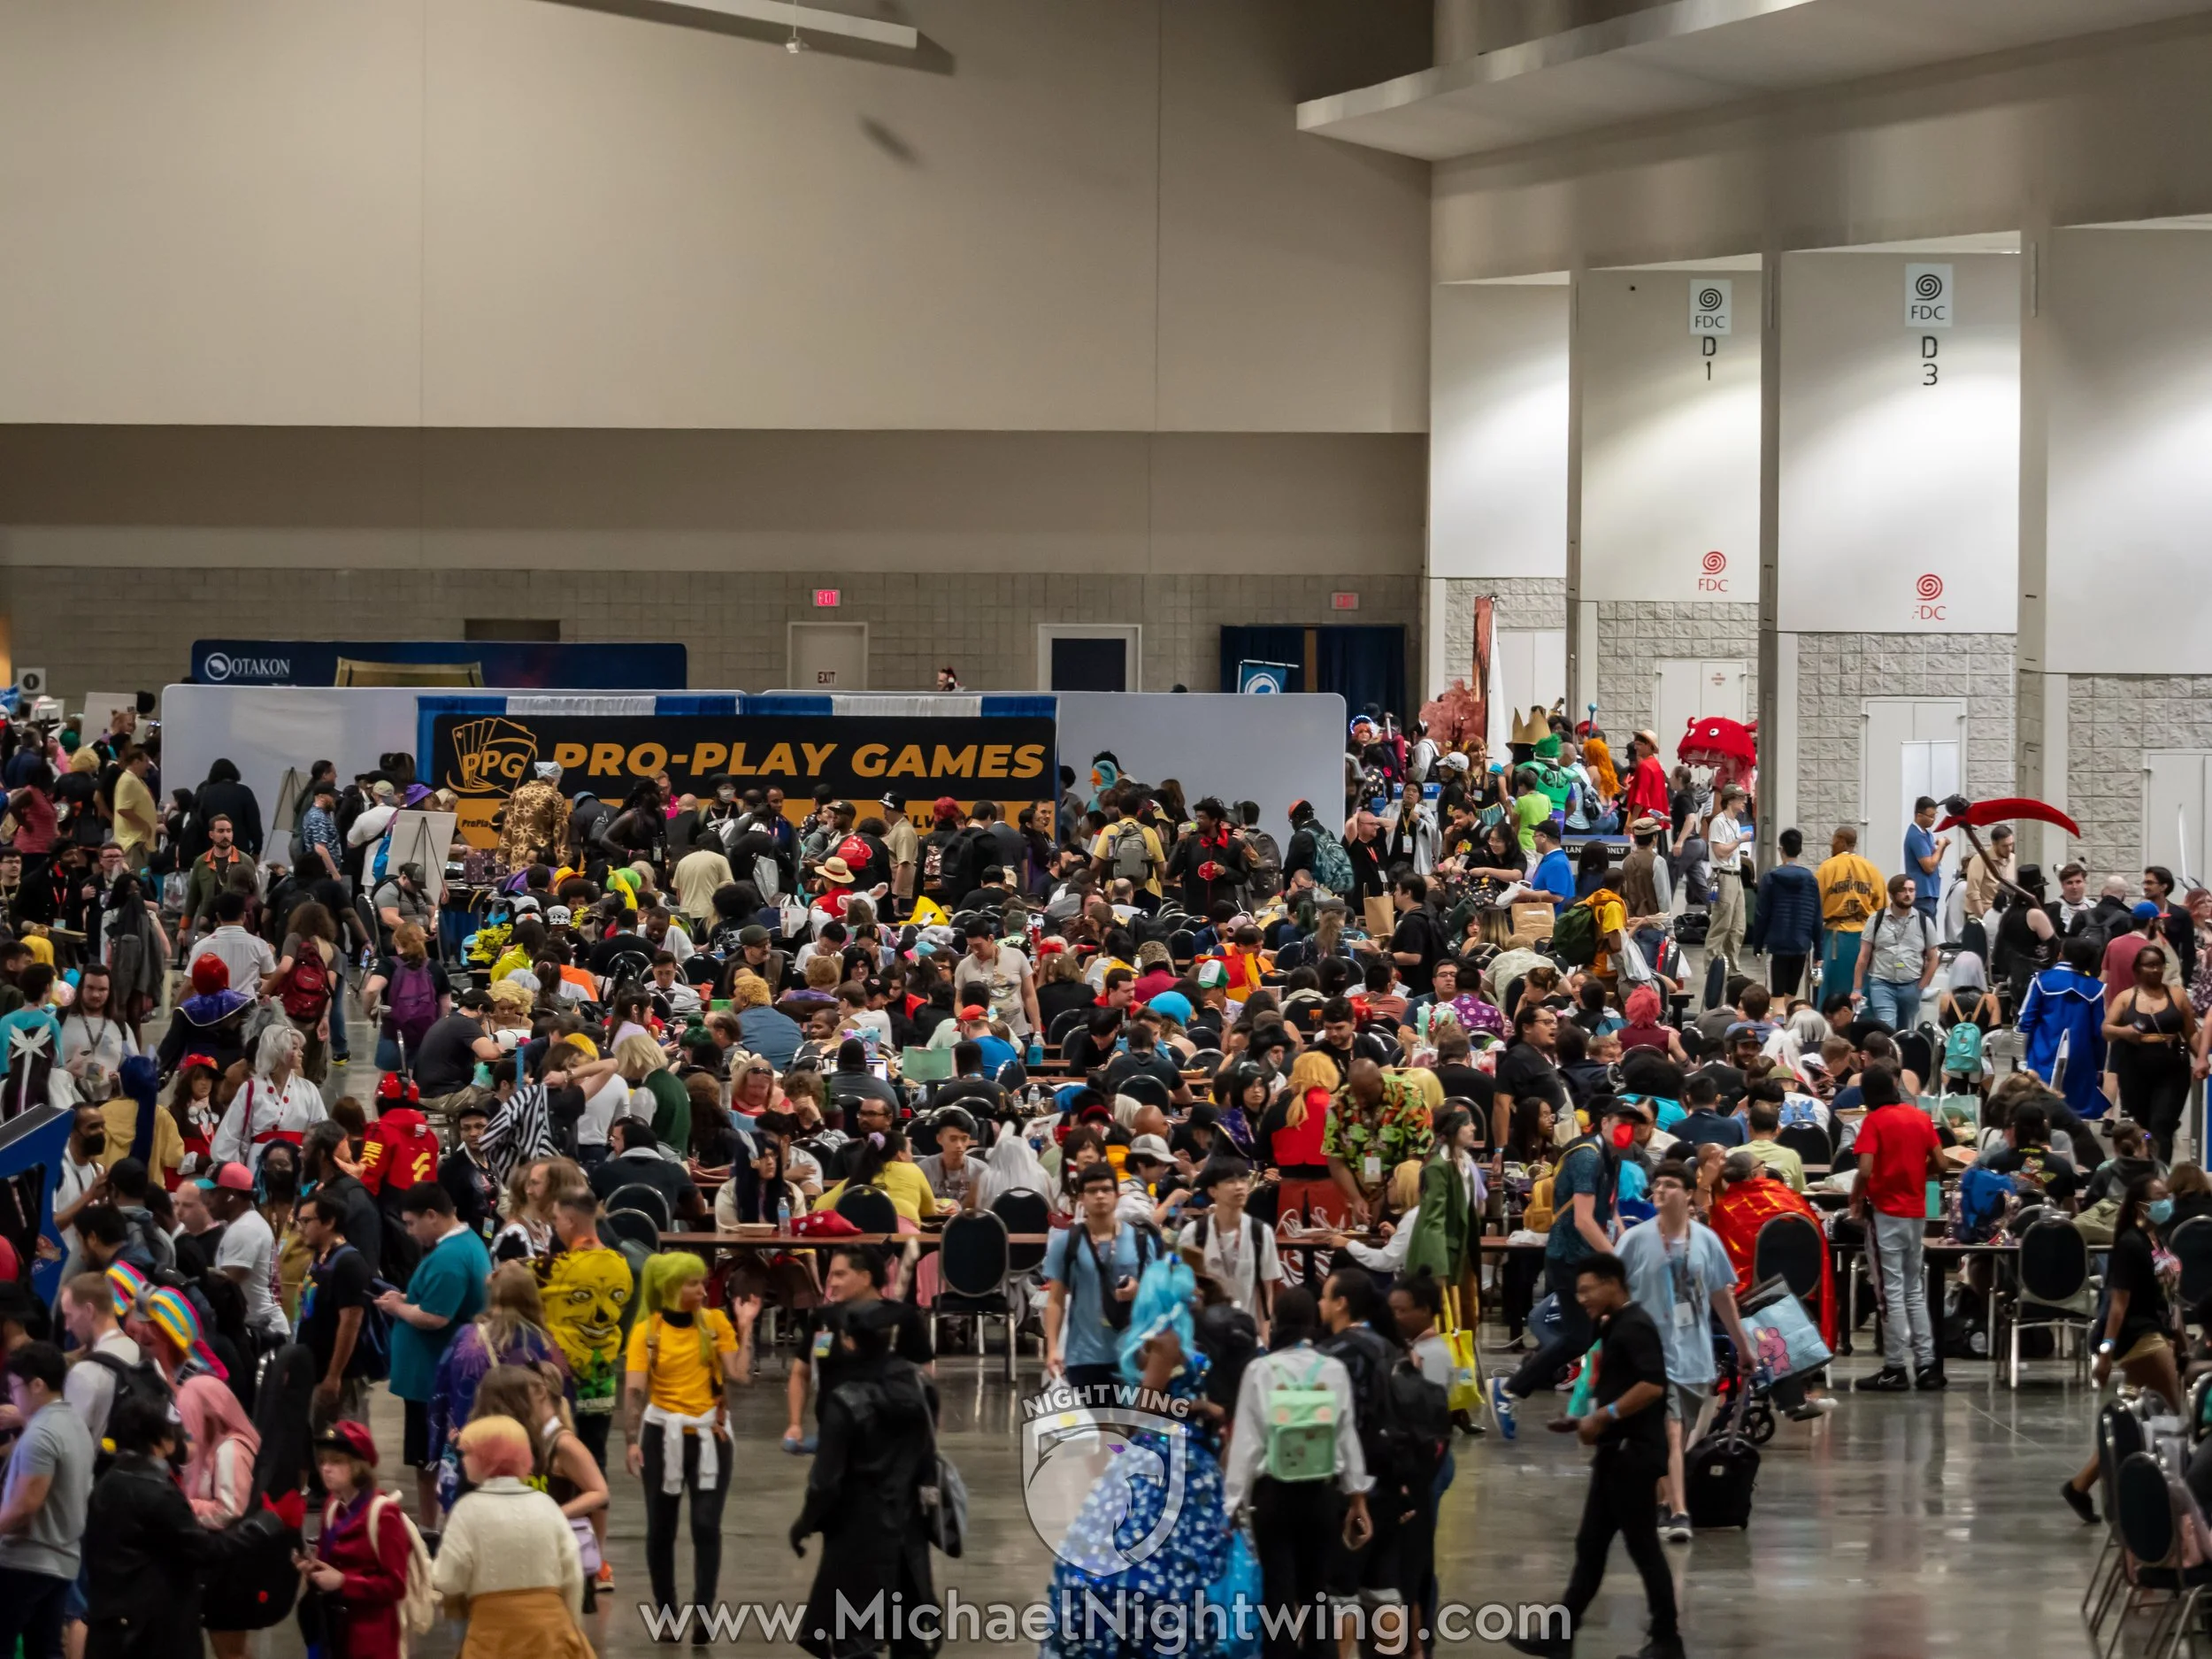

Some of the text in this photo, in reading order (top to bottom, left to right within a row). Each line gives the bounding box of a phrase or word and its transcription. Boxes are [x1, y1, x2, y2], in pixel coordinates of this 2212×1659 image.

[1910, 305, 1946, 320] FDC
[1694, 315, 1725, 329] FDC
[1702, 336, 1717, 357] D
[1922, 335, 1939, 358] D
[1705, 361, 1712, 380] 1
[1923, 363, 1939, 386] 3
[1698, 578, 1729, 592] FDC
[818, 591, 837, 605] EXIT
[232, 658, 290, 675] OTAKON
[818, 672, 835, 684] EXIT
[462, 749, 528, 780] PPG
[553, 742, 1046, 779] PRO-PLAY GAMES
